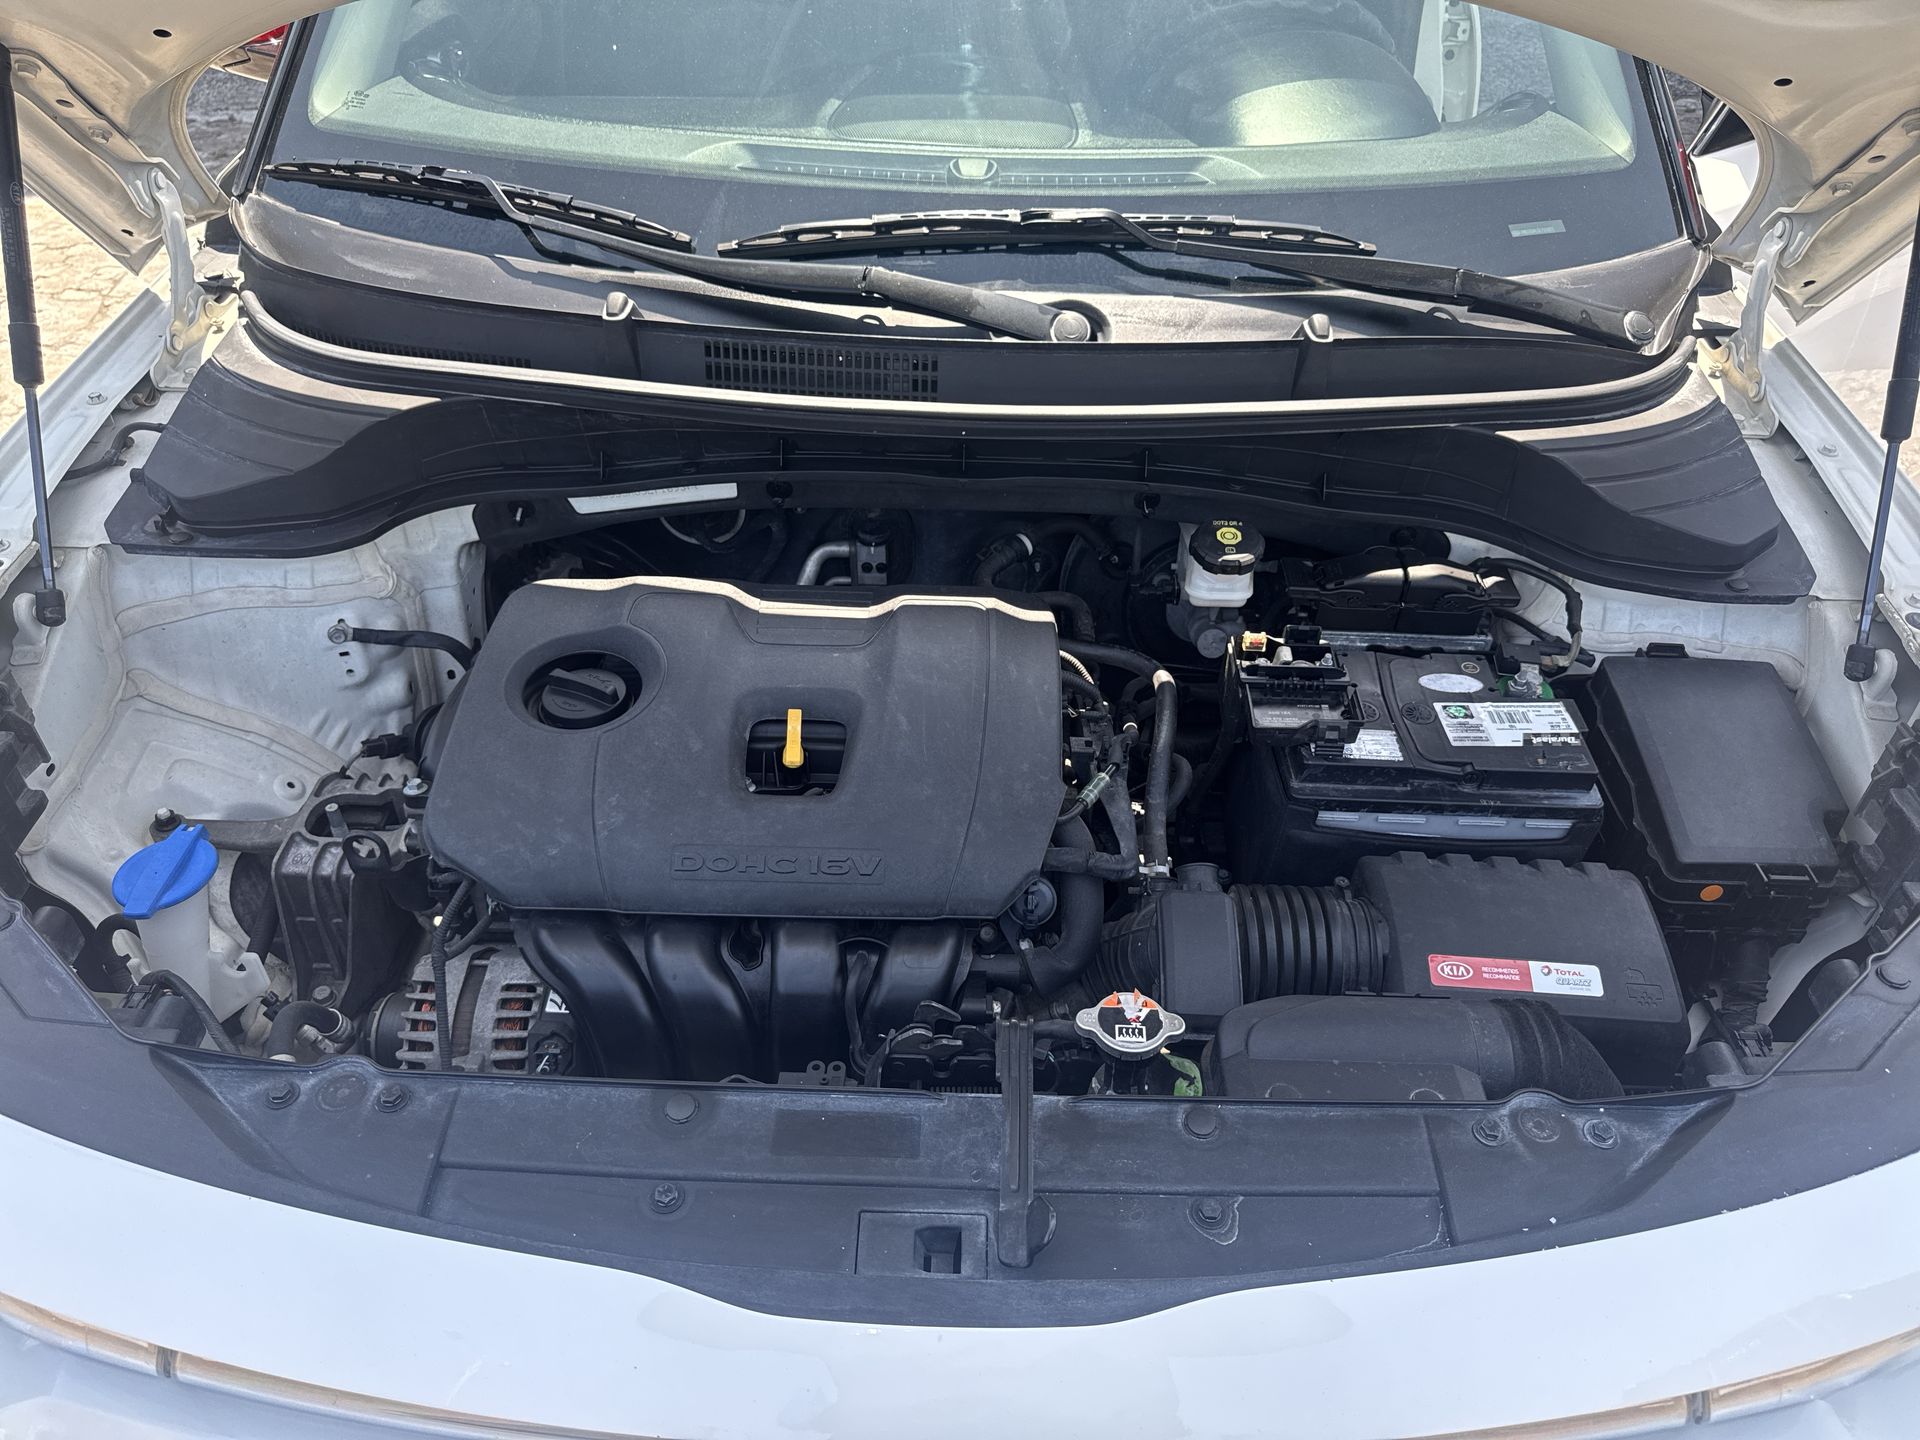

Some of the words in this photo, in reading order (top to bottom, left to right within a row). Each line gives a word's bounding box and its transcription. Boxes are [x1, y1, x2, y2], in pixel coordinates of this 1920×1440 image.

[1531, 736, 1577, 744] Duralast
[673, 852, 798, 875] DOHC
[808, 854, 882, 877] 16V
[1482, 966, 1520, 975] RECOMMENDS
[1553, 968, 1584, 977] TOTAL
[1556, 977, 1592, 987] QUARTZ
